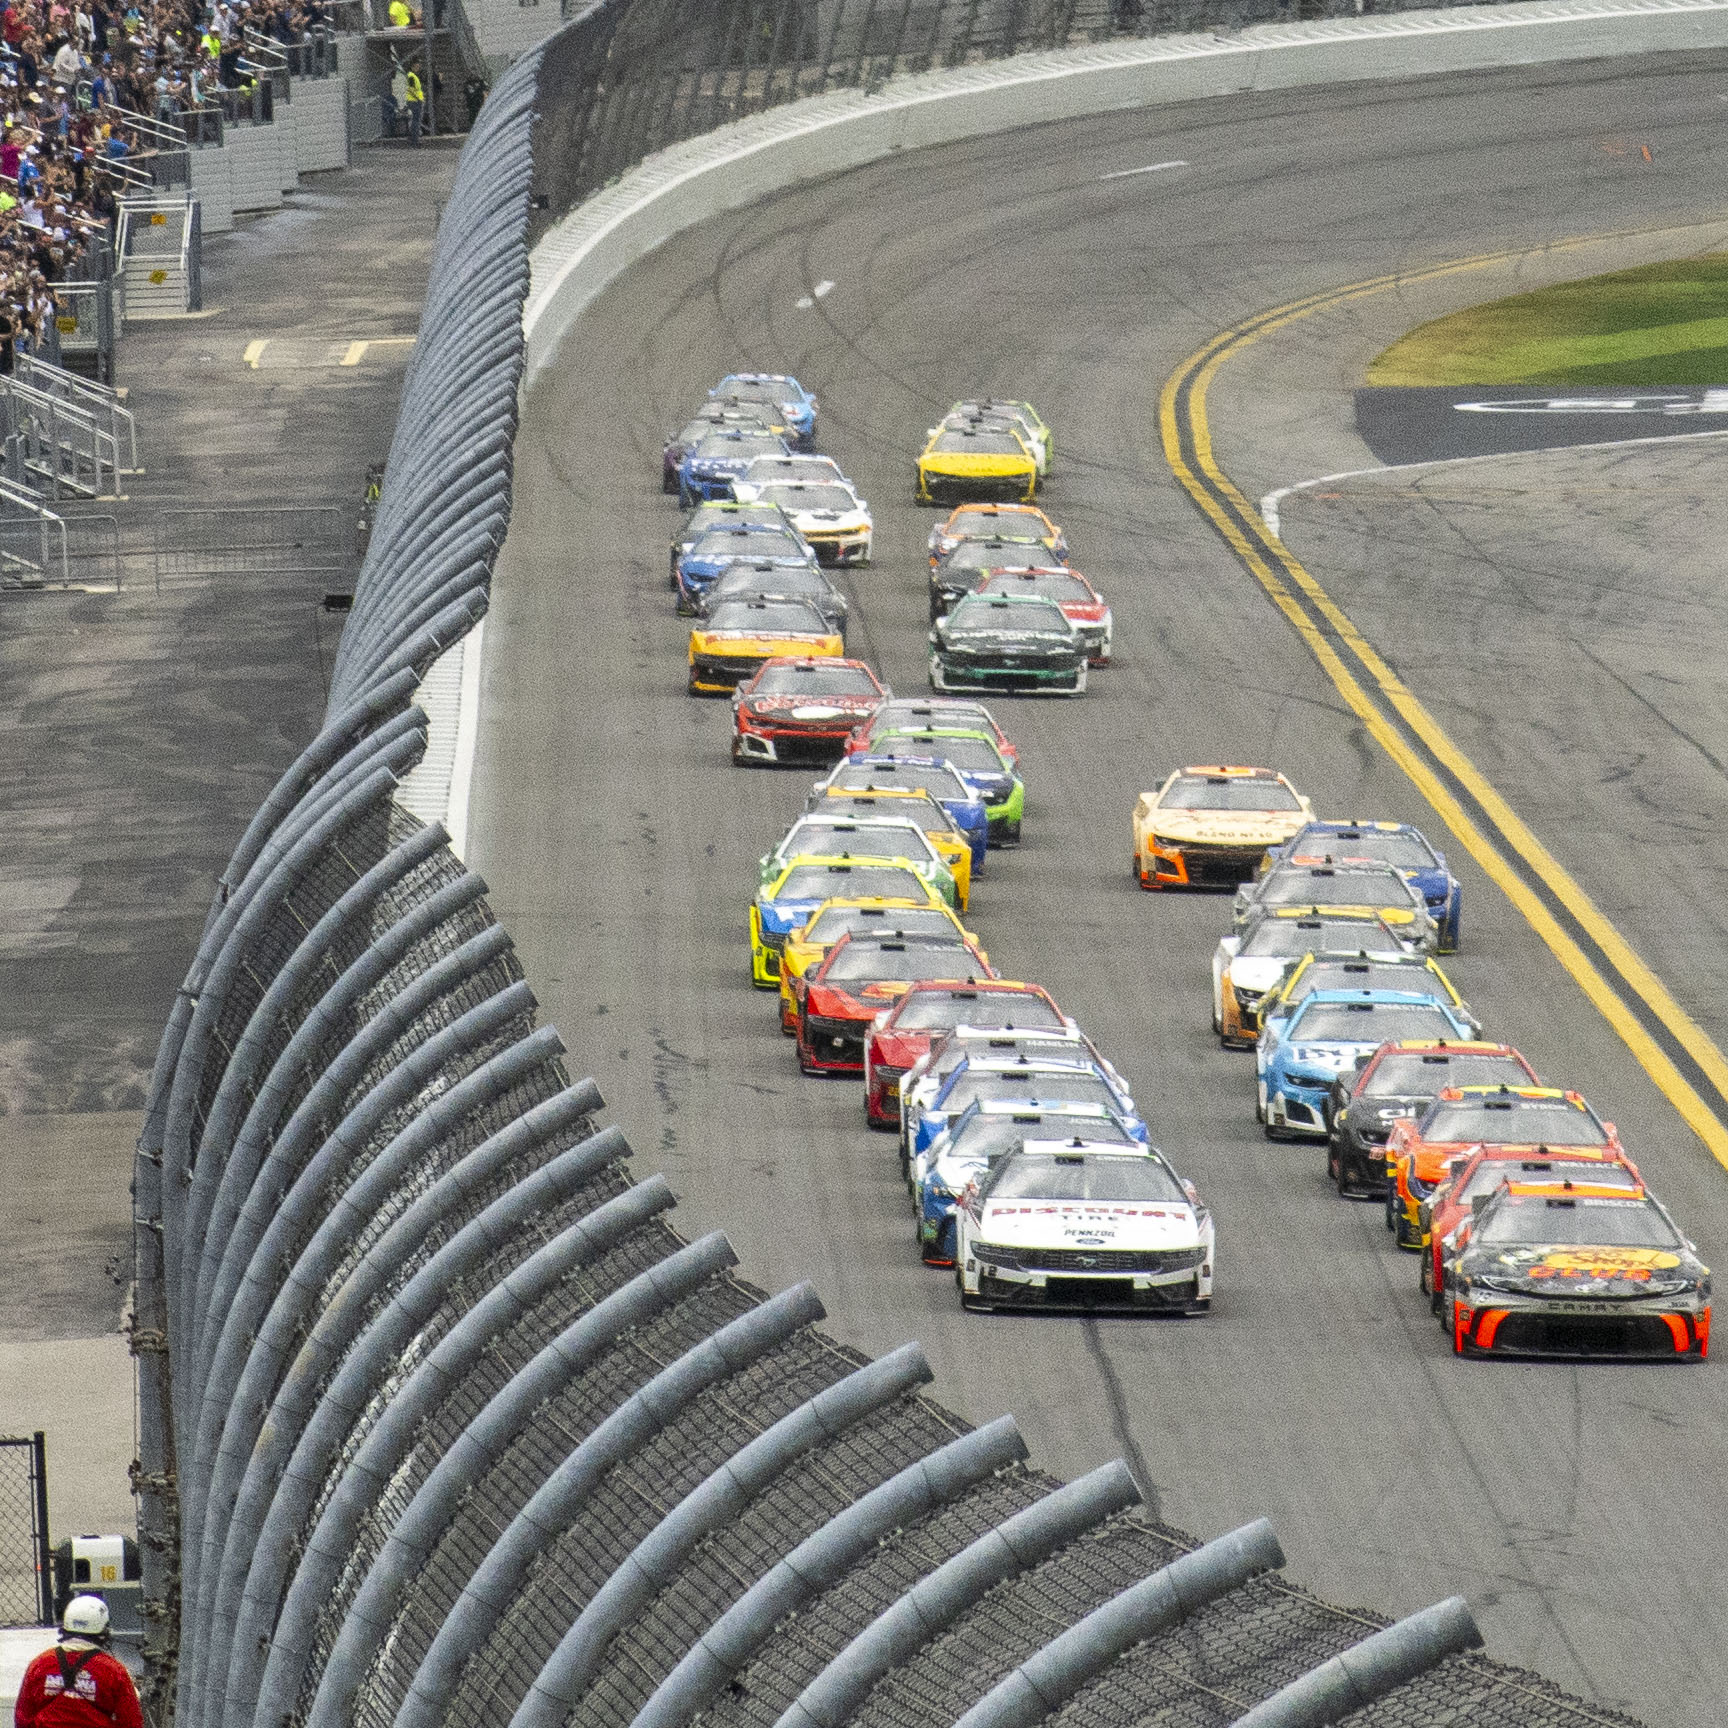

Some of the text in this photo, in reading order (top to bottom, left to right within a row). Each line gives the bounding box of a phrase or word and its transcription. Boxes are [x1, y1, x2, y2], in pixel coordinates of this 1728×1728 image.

[1064, 1228, 1116, 1238] PENNZOIL
[1527, 1265, 1652, 1281] CLUB
[1548, 1301, 1625, 1311] CAMRY
[100, 1565, 115, 1581] 16
